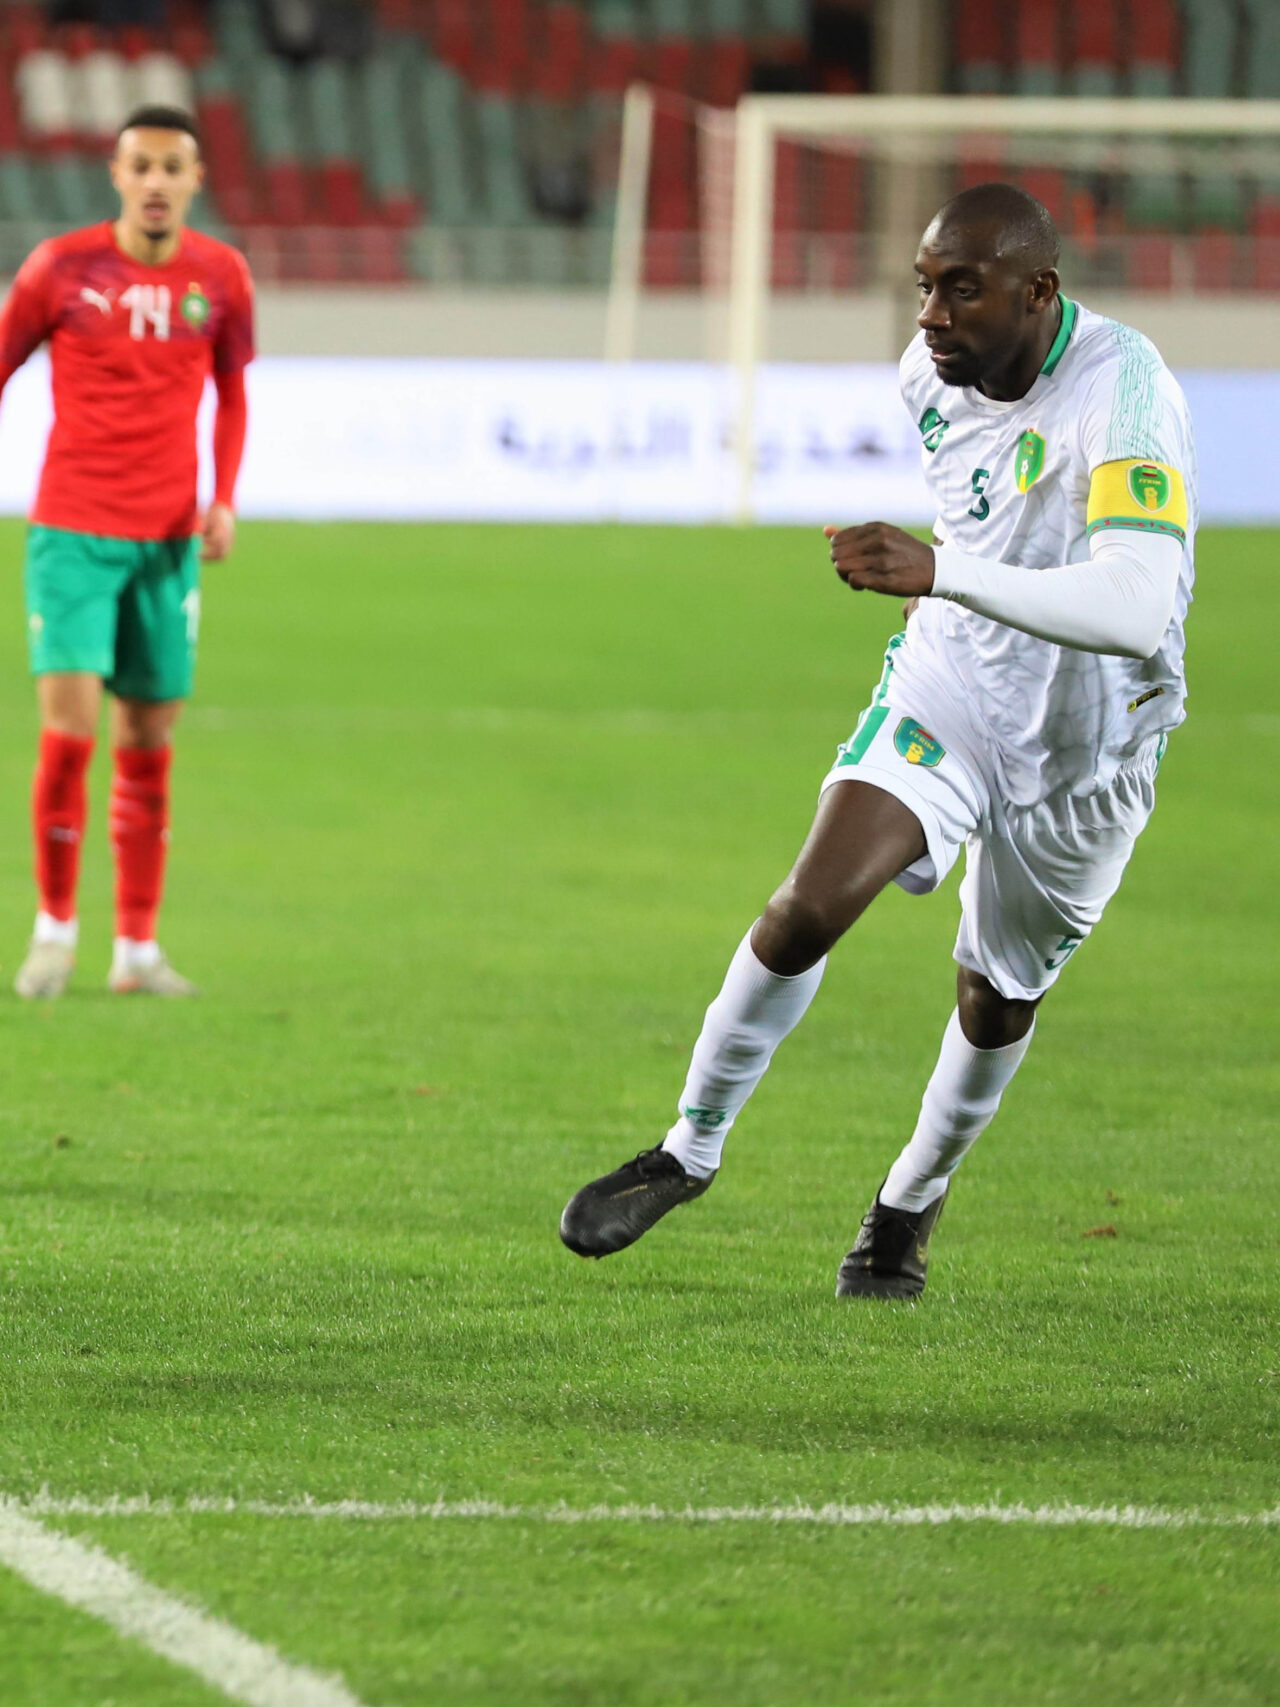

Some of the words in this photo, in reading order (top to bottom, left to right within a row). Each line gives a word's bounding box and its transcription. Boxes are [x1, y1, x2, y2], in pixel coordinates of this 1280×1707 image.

[119, 284, 172, 342] 14
[968, 468, 990, 521] 5
[1044, 934, 1083, 971] 5
